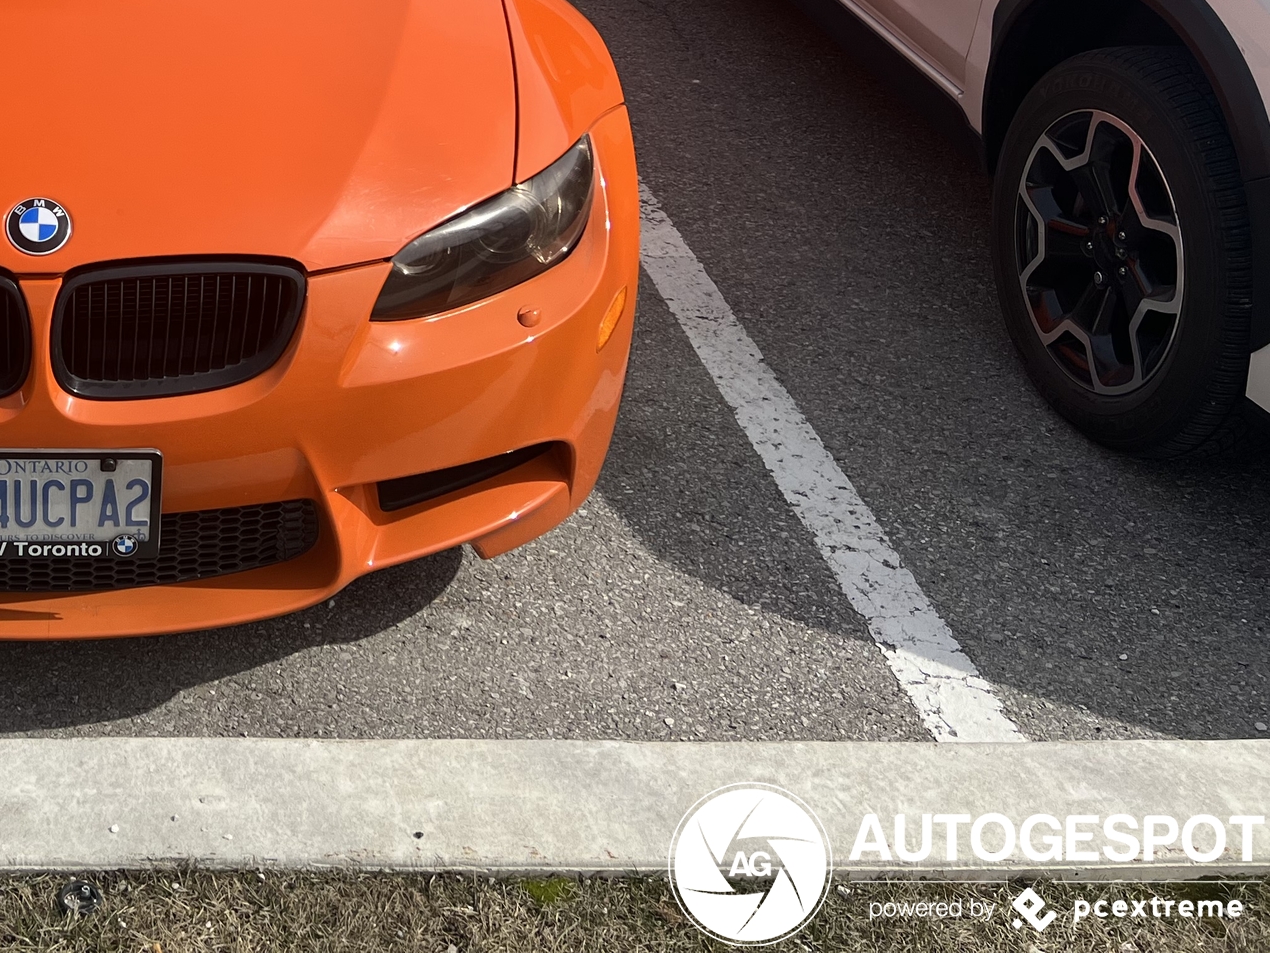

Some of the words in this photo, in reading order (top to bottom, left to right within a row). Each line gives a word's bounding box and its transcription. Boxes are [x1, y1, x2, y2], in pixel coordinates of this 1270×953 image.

[14, 199, 65, 217] BMW
[42, 533, 95, 541] DISCOVER
[14, 541, 103, 557] Toronto
